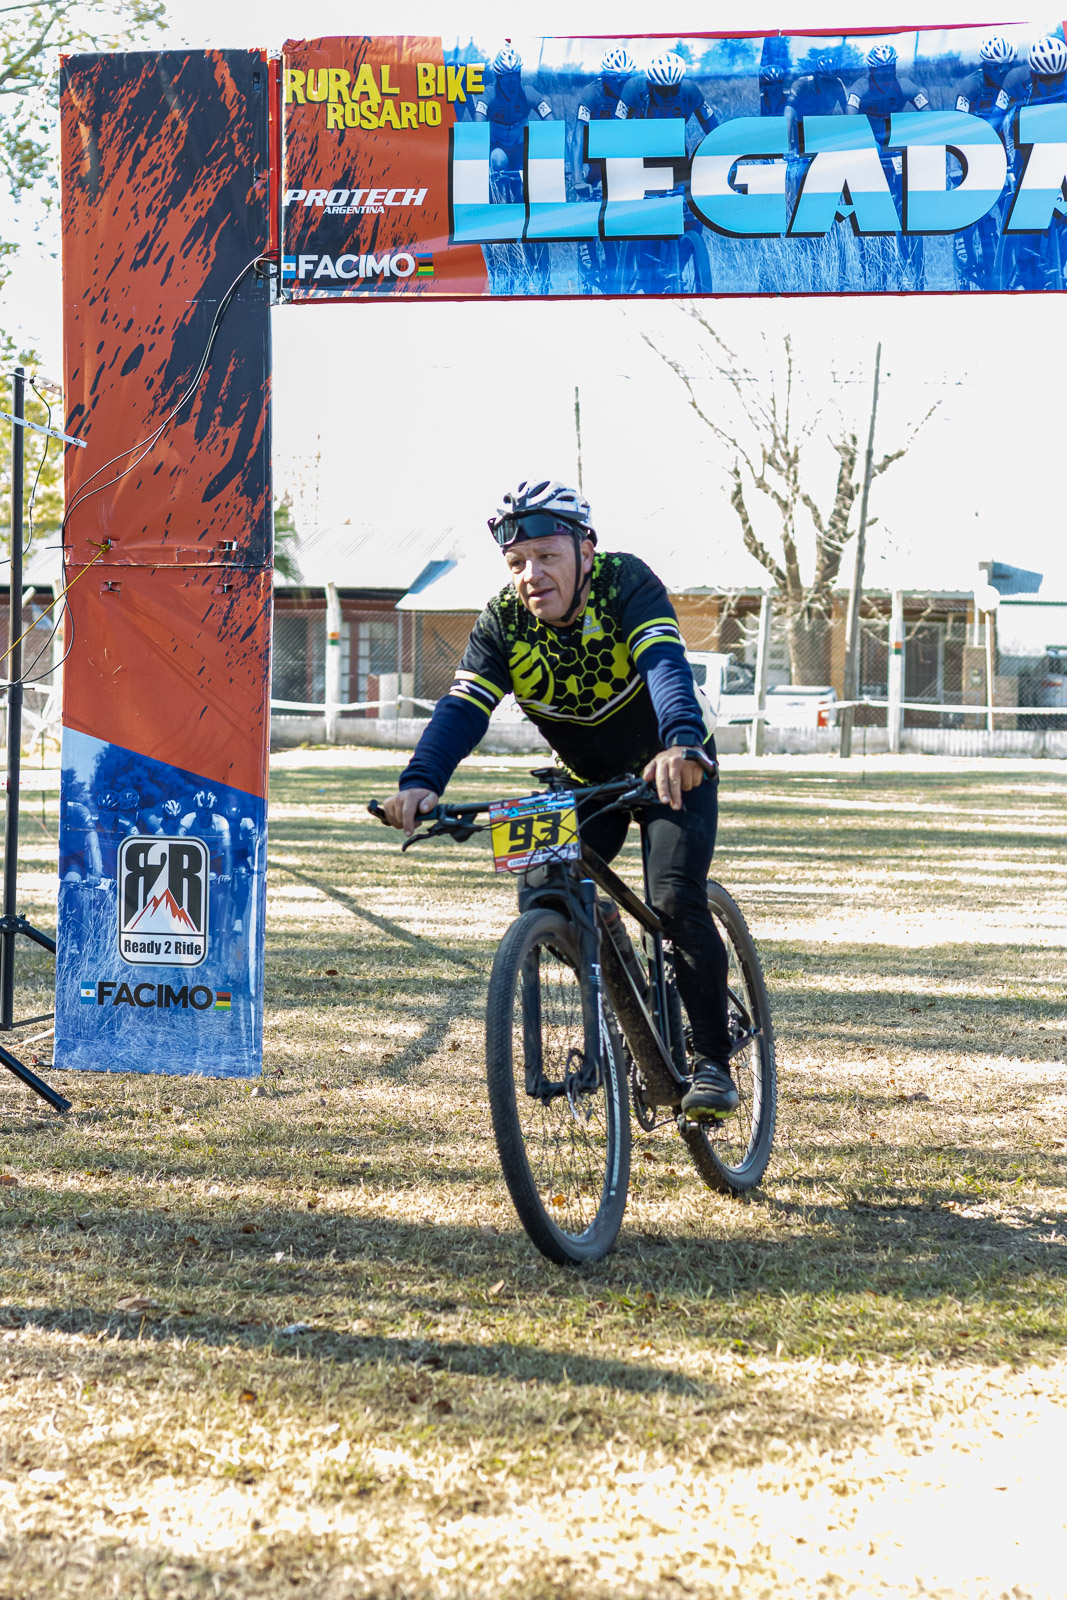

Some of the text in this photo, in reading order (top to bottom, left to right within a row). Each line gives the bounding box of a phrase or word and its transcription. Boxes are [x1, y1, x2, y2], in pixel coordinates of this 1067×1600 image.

[284, 62, 485, 104] RURAL BIKE
[326, 100, 442, 130] ROSARIO
[283, 188, 428, 206] PROTECH
[323, 206, 385, 214] ARGENTINA
[298, 253, 416, 279] FACIMO
[508, 812, 561, 853] 93
[124, 940, 202, 956] Ready 2 Ride
[97, 981, 214, 1011] FACIMO
